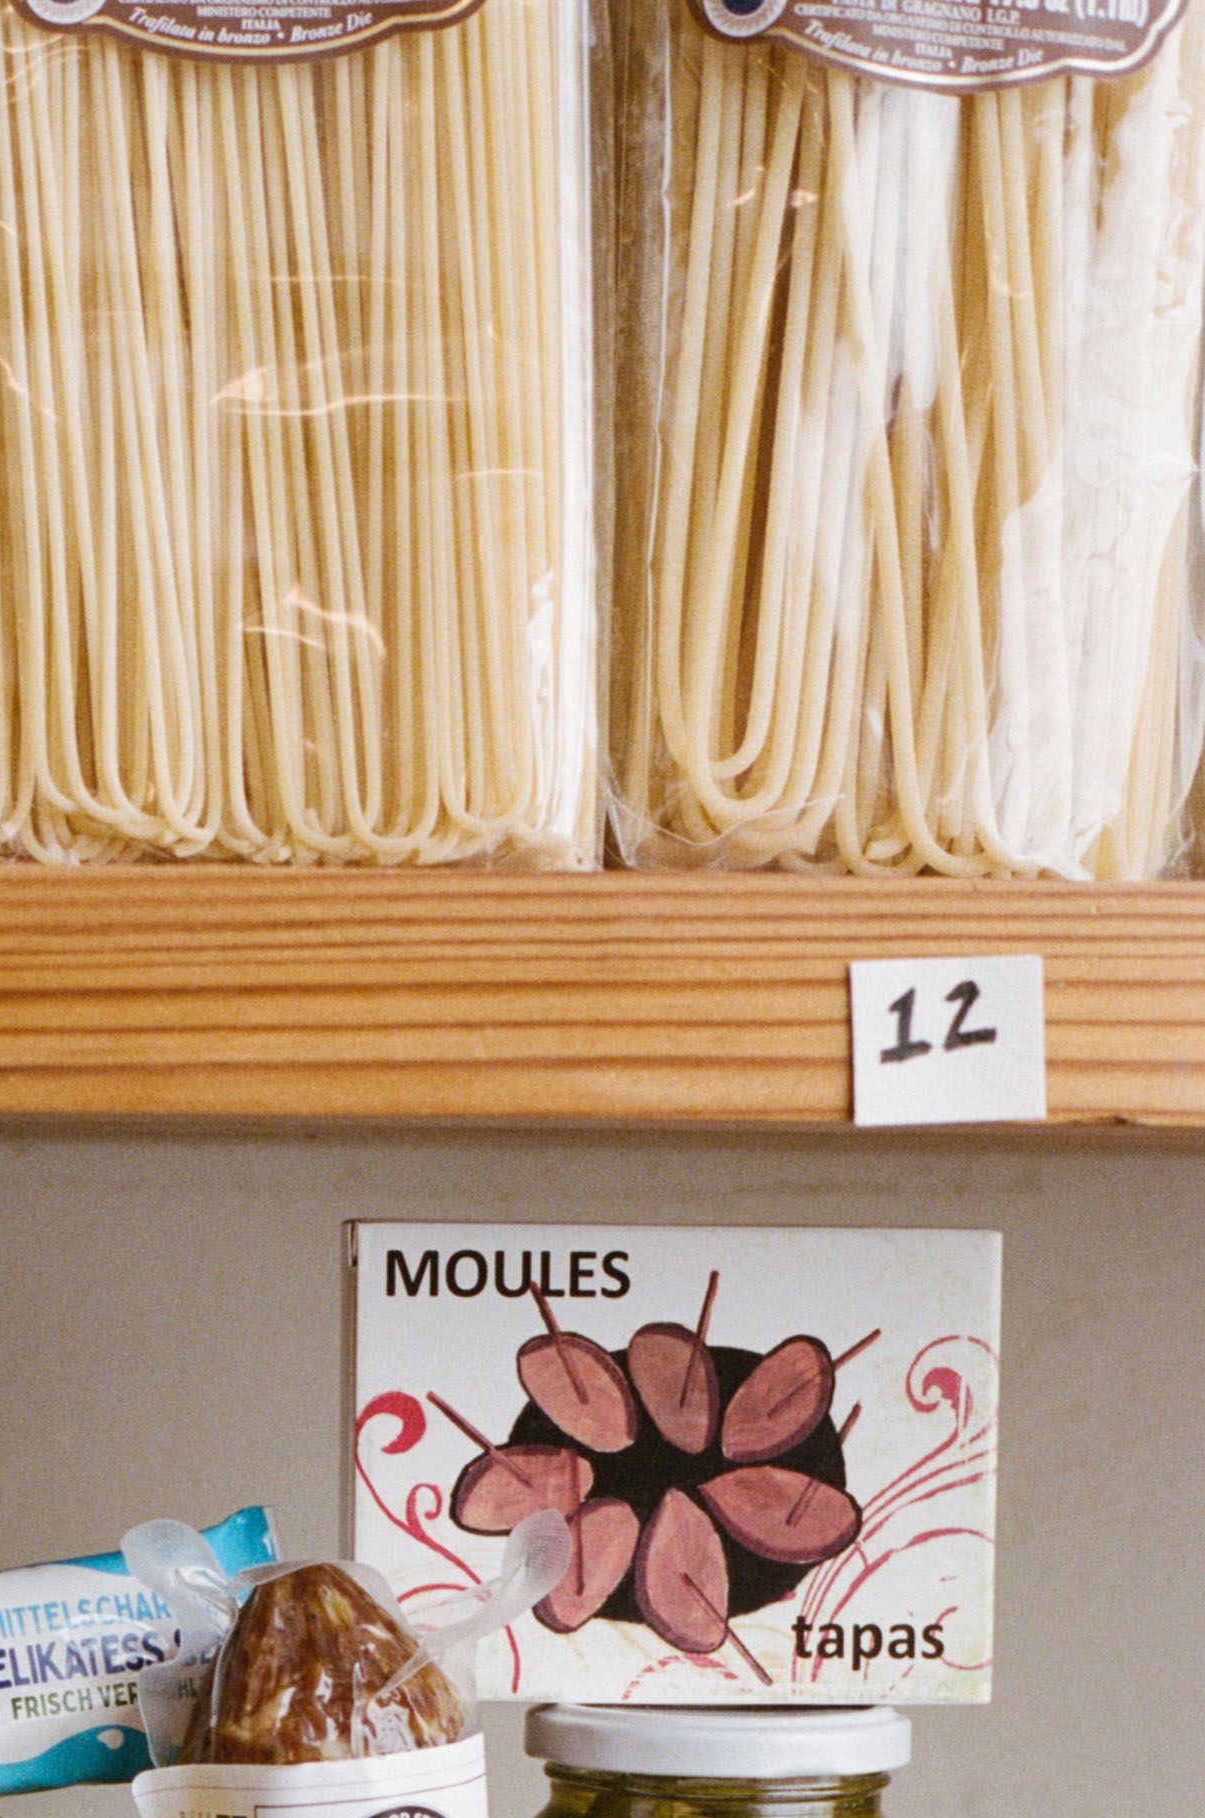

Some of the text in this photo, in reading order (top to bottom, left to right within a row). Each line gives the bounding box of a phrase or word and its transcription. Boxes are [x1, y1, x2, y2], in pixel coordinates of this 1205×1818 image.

[198, 26, 214, 42] in
[217, 30, 271, 45] bronzo
[290, 21, 343, 43] Bronze
[346, 12, 373, 33] Die
[241, 18, 281, 31] ITALIA
[879, 979, 998, 1064] 12
[385, 1249, 632, 1299] MOULES
[791, 1615, 945, 1671] tapas
[10, 1687, 93, 1720] FRISCH
